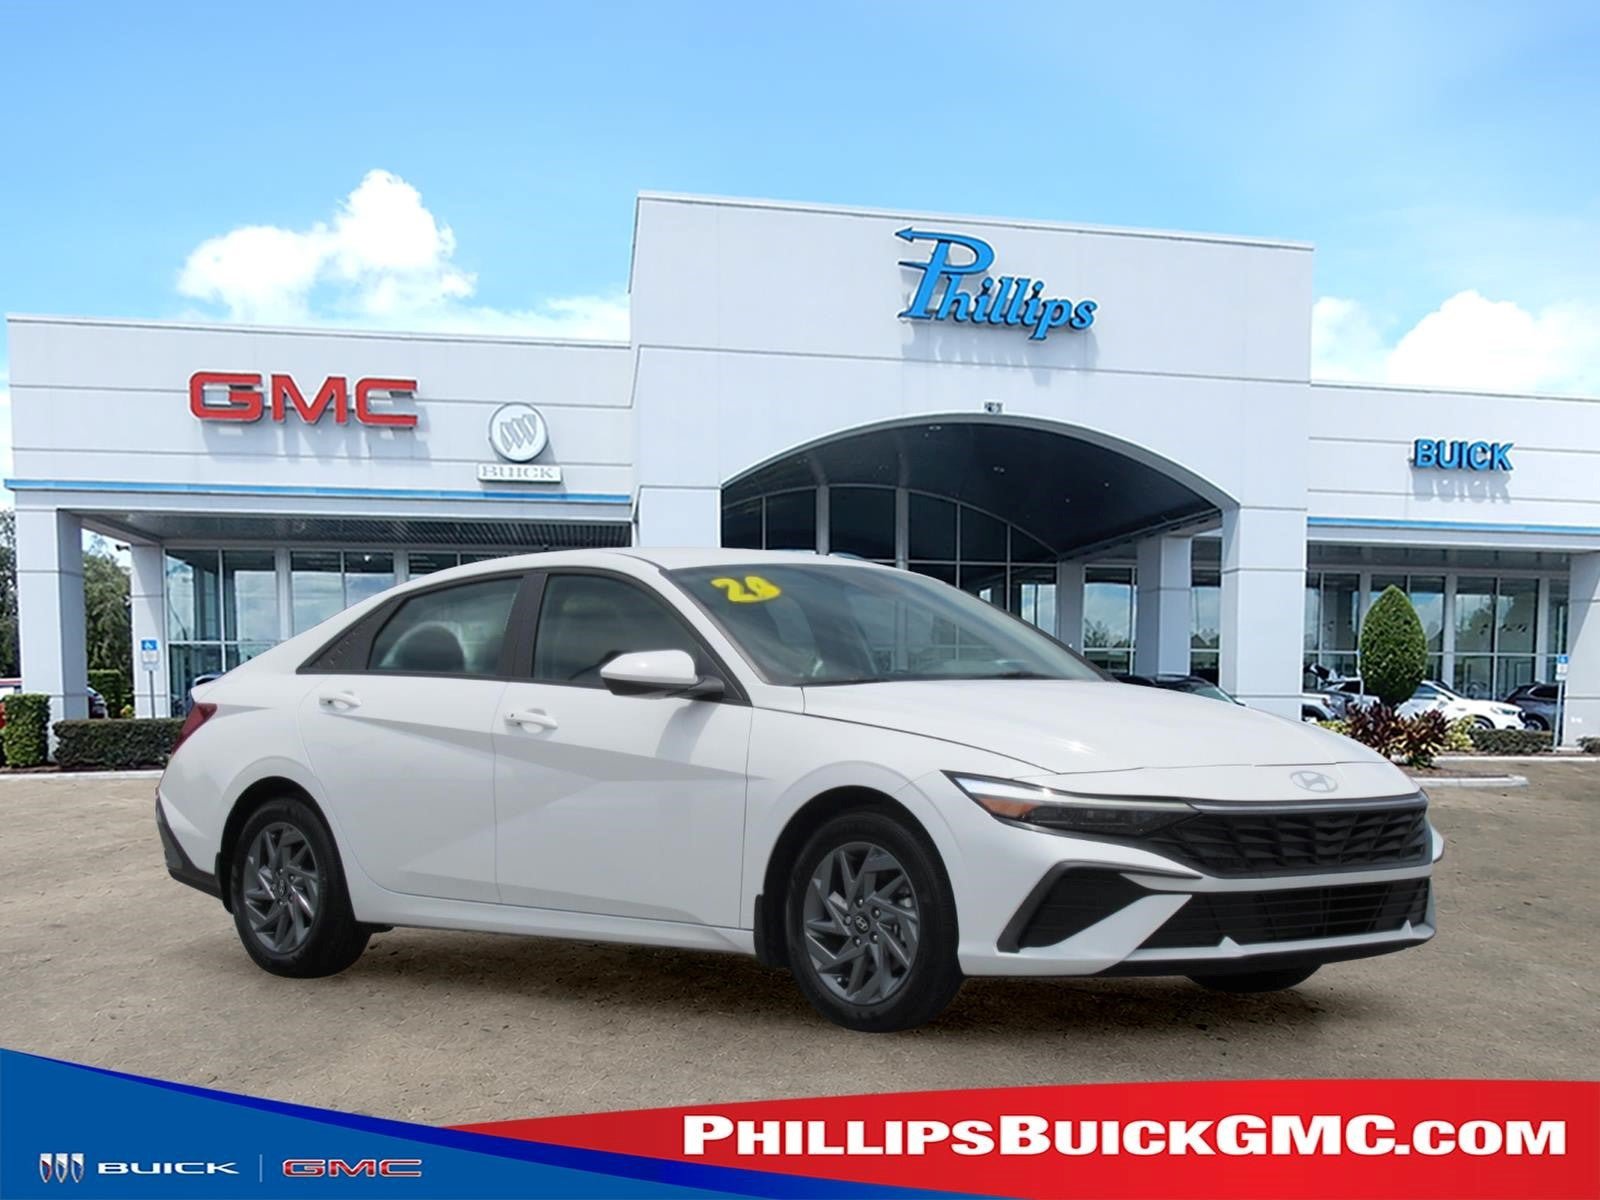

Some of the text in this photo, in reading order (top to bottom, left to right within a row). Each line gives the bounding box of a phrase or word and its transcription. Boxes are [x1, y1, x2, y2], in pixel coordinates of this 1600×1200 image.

[895, 226, 1098, 341] Phillips
[189, 371, 418, 428] GMC
[481, 465, 555, 479] BUICK
[1413, 438, 1514, 471] BUICK
